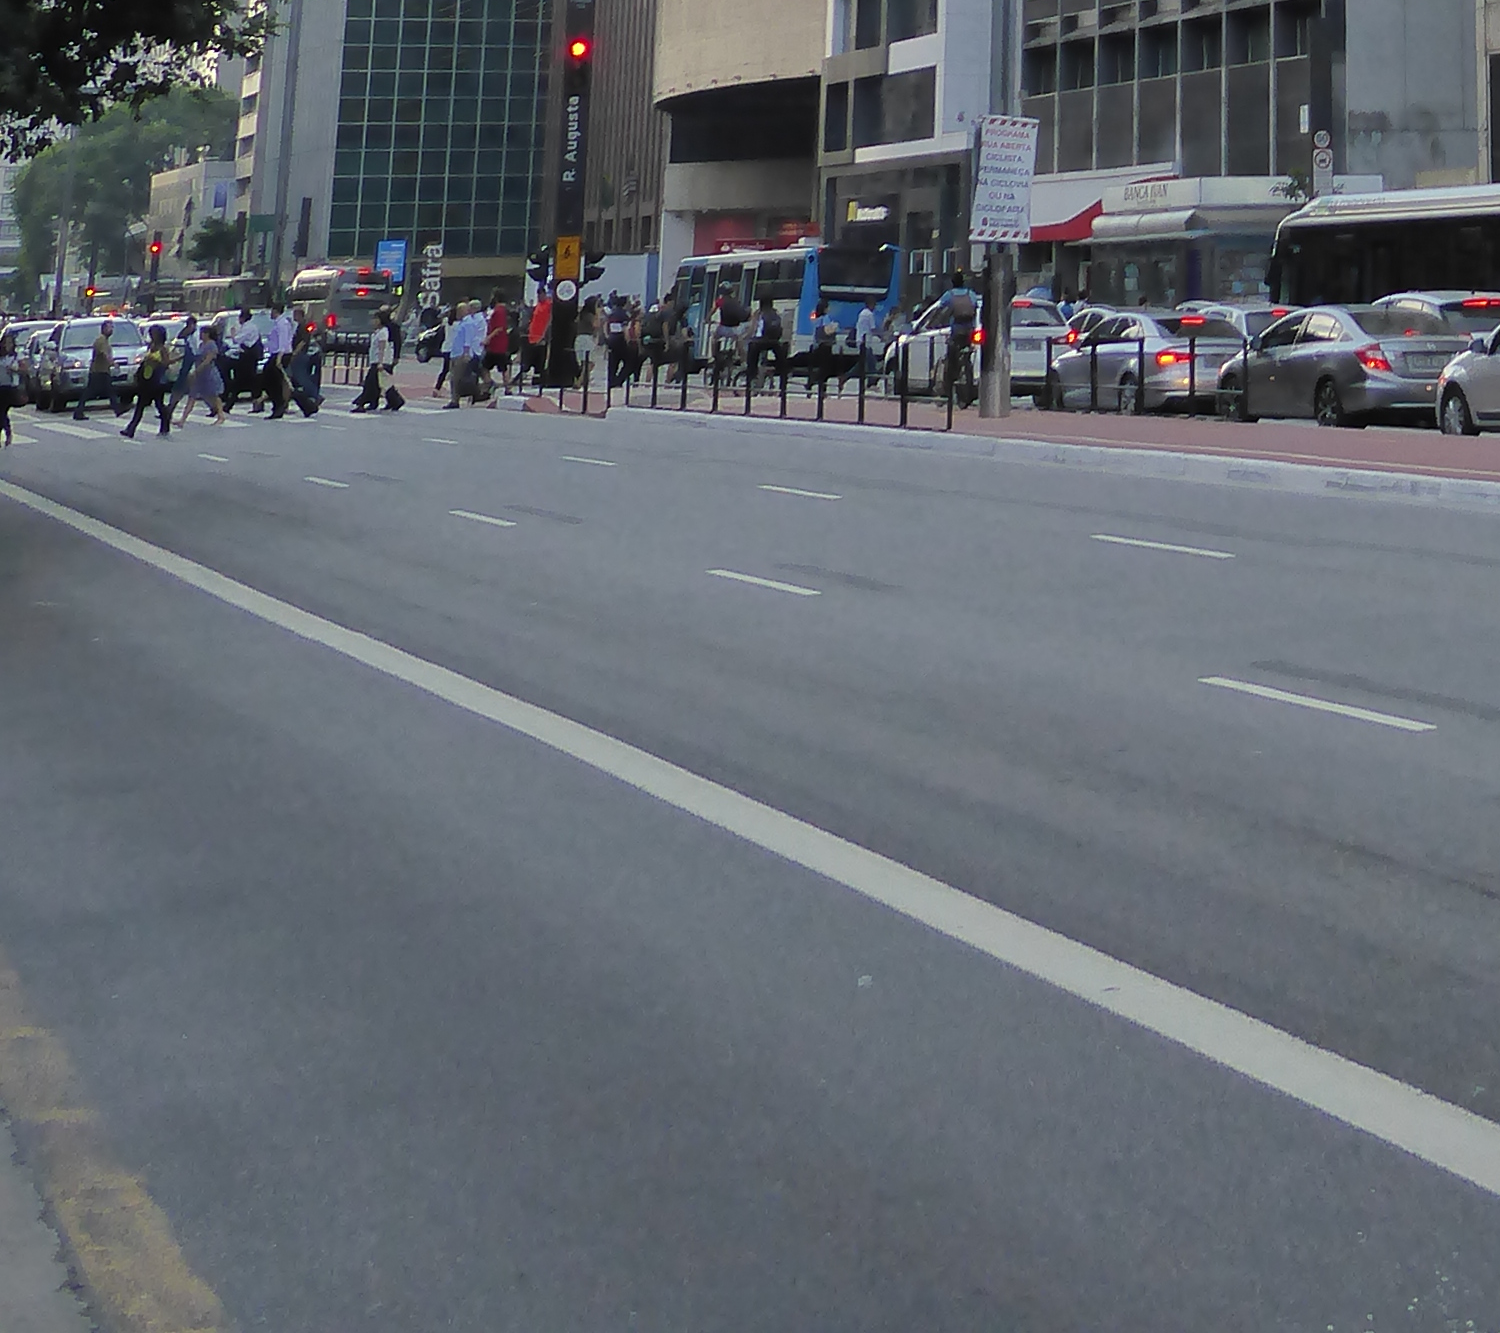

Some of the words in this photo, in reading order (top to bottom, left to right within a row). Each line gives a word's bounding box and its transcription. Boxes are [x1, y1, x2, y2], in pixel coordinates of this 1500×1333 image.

[564, 95, 582, 162] Augusta
[985, 128, 1030, 140] PROGRAMA
[1000, 142, 1031, 152] ABERTA
[562, 168, 576, 182] R.
[988, 190, 1002, 200] OU
[1124, 185, 1148, 201] BANCA
[419, 243, 443, 309] Safra
